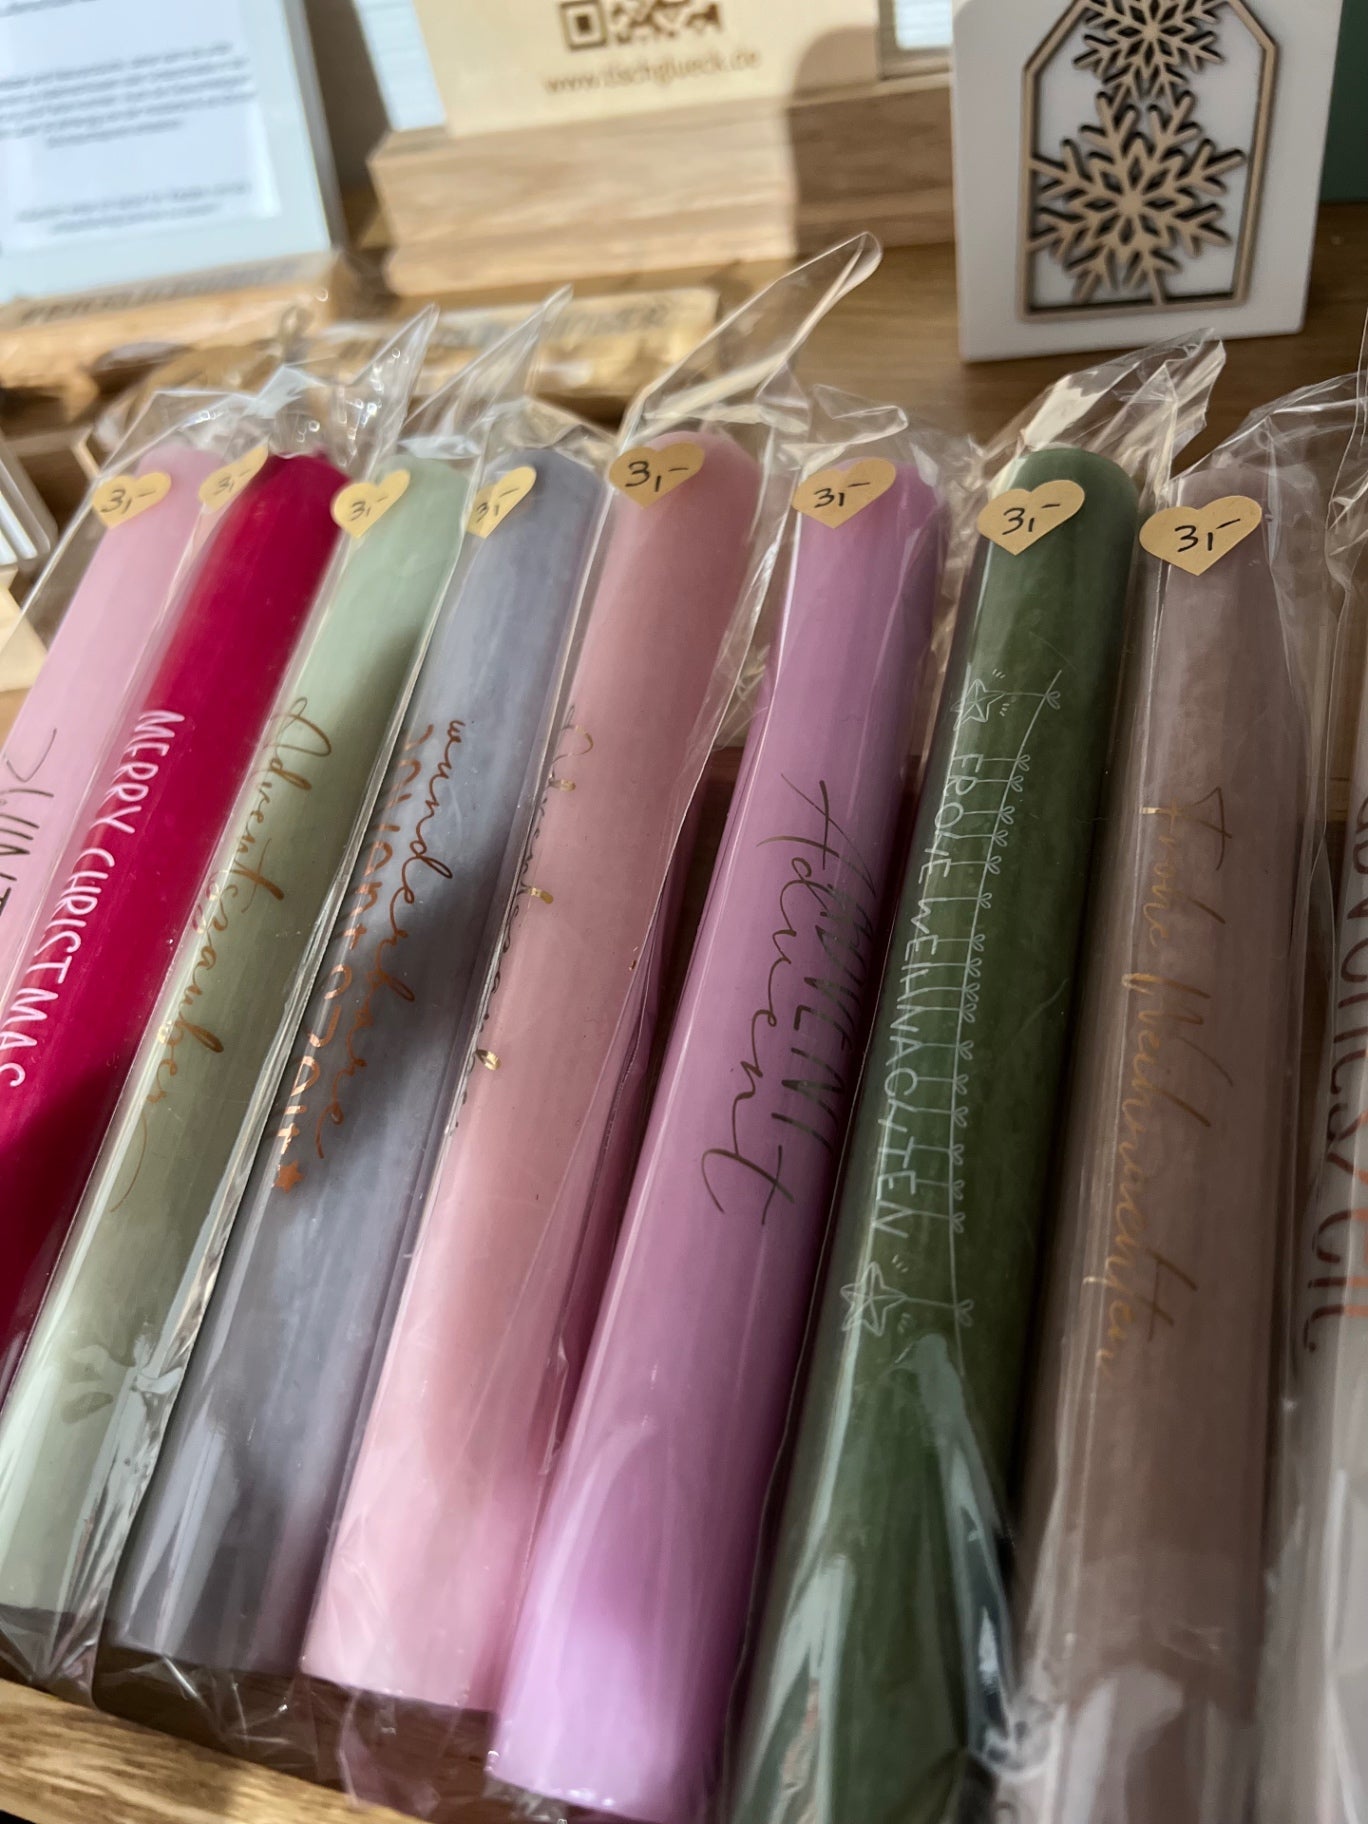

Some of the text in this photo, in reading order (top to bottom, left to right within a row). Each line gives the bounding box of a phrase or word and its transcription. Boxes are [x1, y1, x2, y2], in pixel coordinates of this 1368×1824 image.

[89, 708, 186, 835] MERRY
[1140, 785, 1233, 948] Frohe
[315, 719, 466, 1160] wunderbare
[702, 772, 877, 1225] Advent
